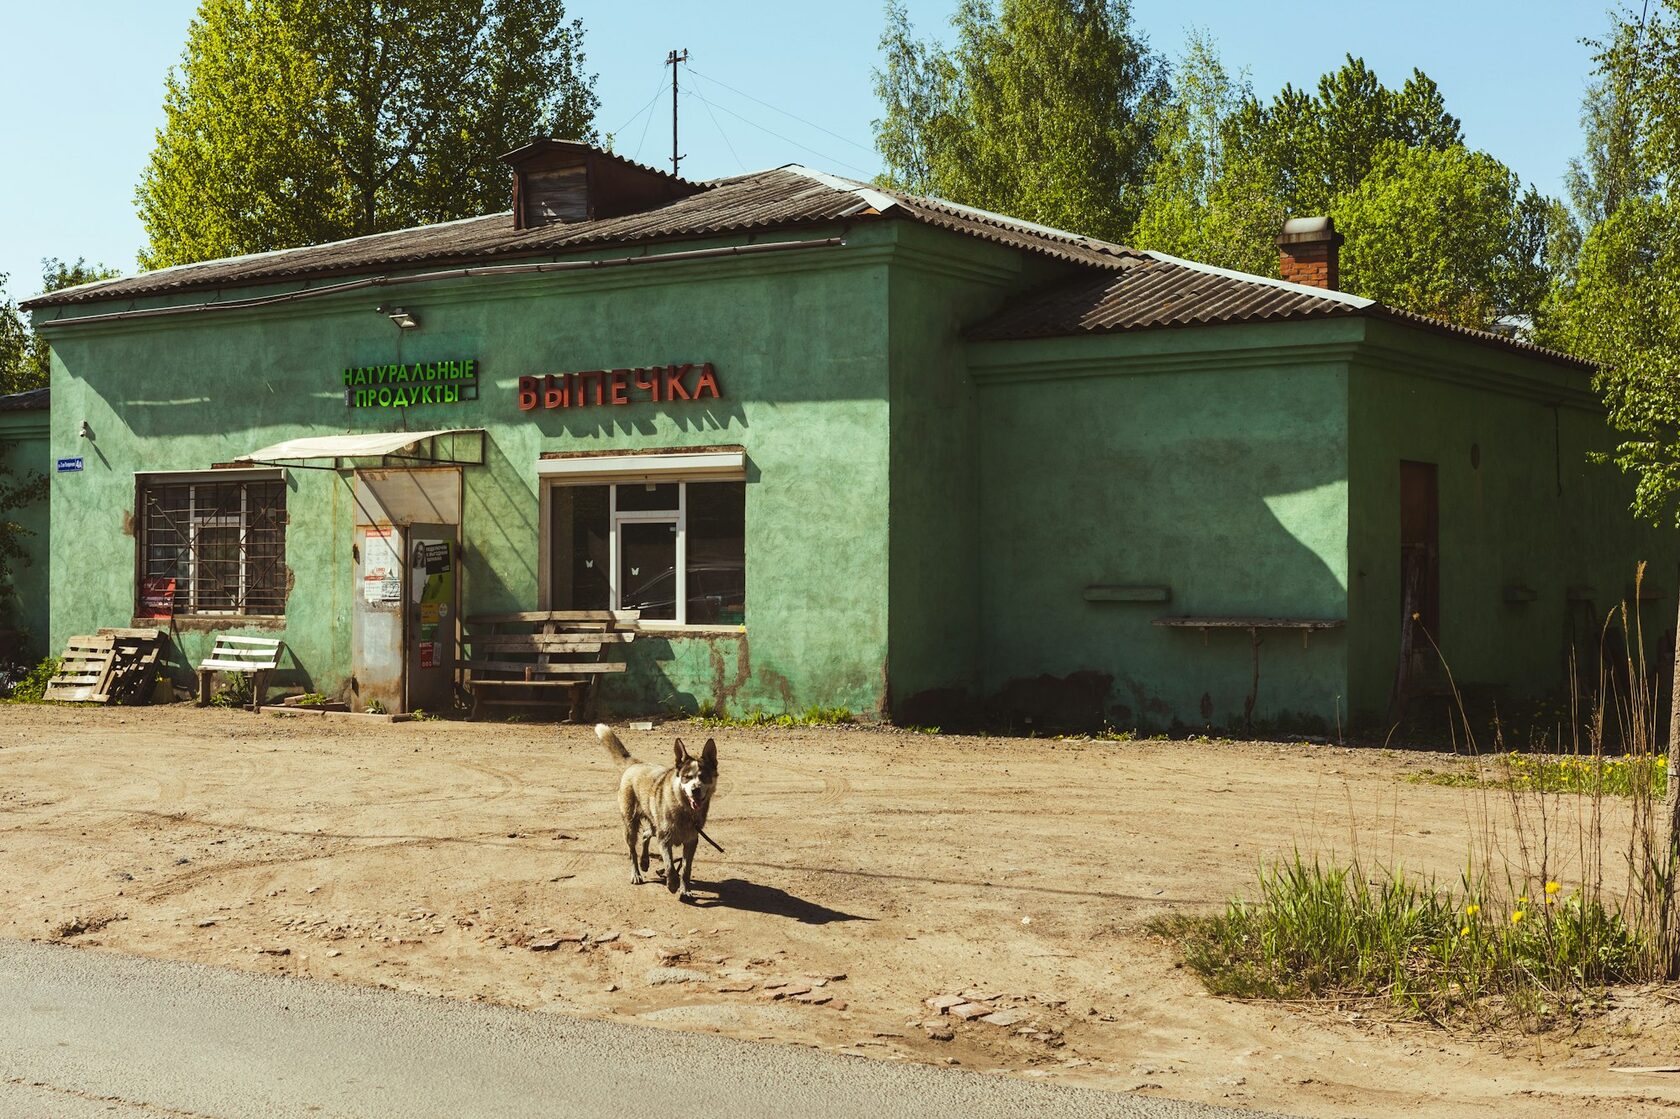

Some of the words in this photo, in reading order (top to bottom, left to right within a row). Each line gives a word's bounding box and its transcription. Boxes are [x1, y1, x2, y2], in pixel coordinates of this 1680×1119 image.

[343, 360, 474, 385] НАТУРАЛЬНЫЕ
[355, 384, 459, 408] ПРОДУКТЫ
[519, 363, 721, 411] ВЫПЕЧКА
